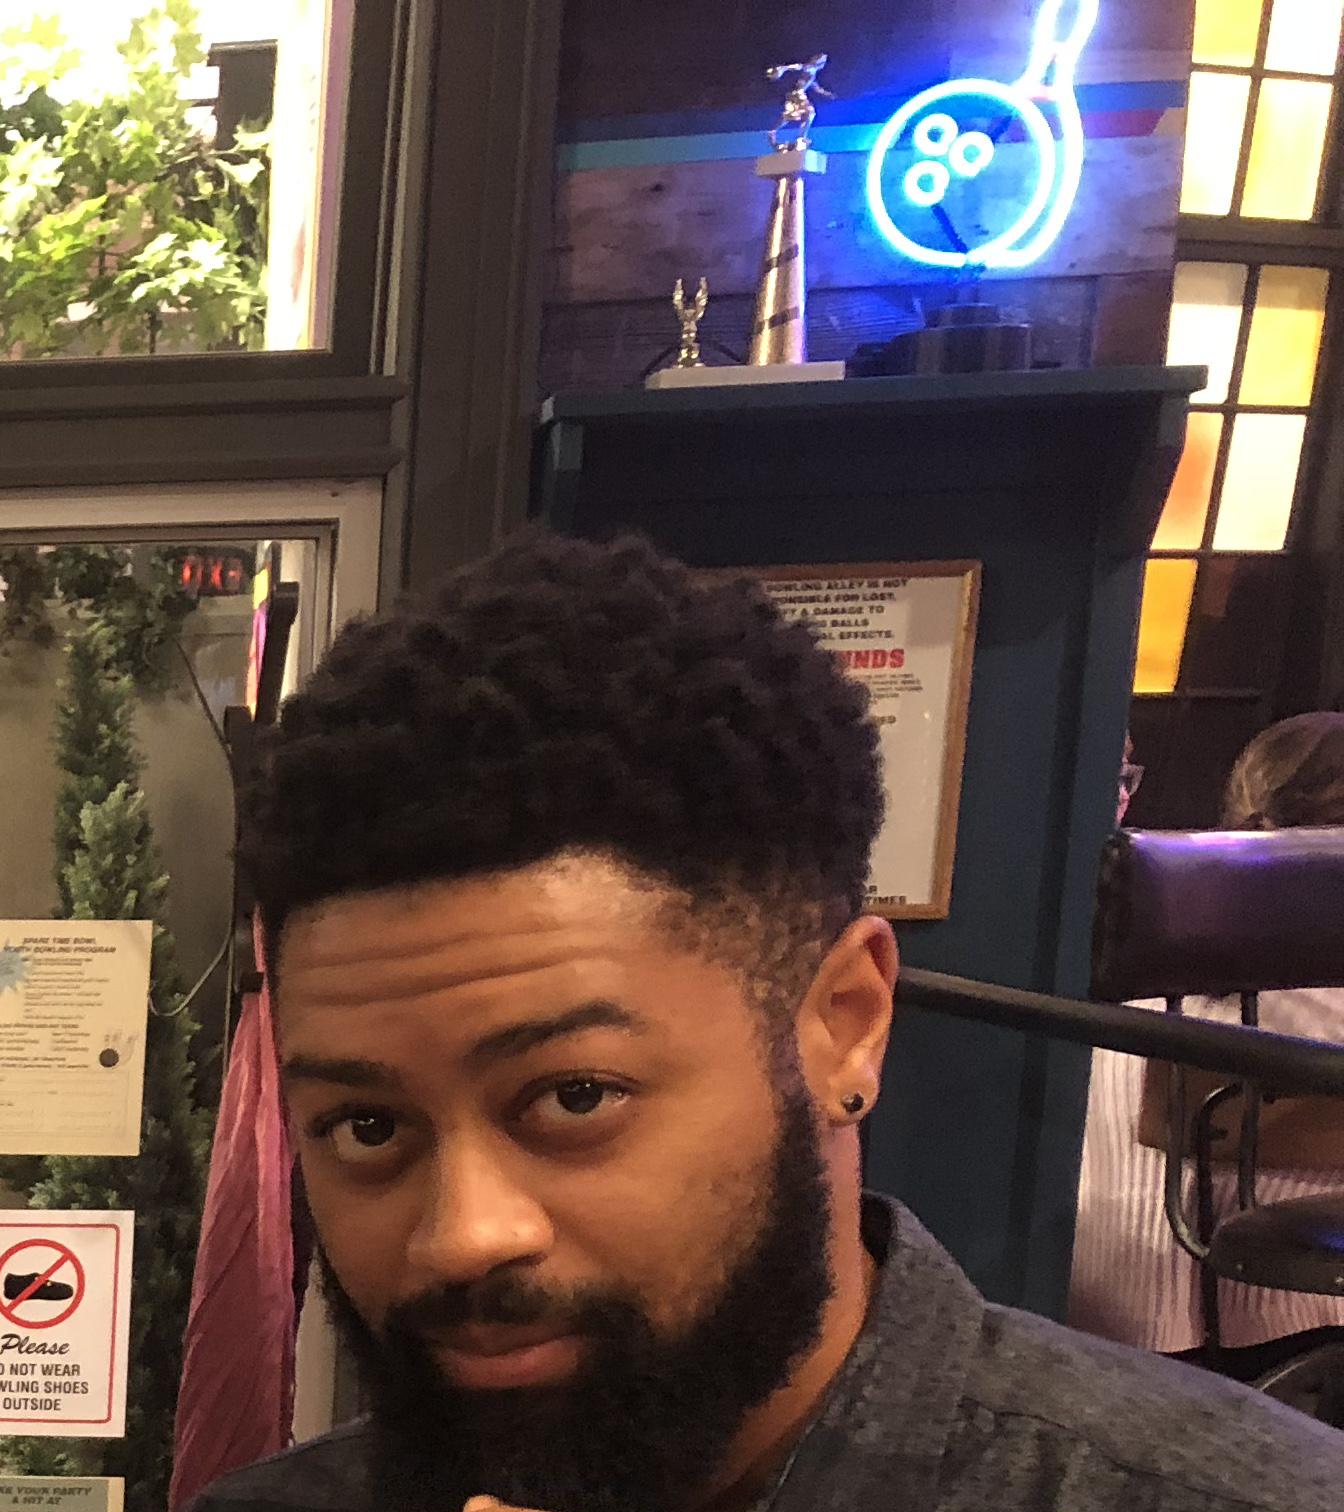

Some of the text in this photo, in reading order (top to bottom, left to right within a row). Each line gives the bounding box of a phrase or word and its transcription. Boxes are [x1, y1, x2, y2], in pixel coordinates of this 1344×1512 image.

[826, 579, 864, 590] ALLEY
[883, 578, 909, 588] NOT
[834, 593, 861, 603] FOR
[813, 605, 864, 616] DAMAGE
[869, 605, 885, 614] TO
[831, 618, 870, 627] BALLS
[0, 1333, 70, 1356] Please
[9, 1362, 36, 1377] NOT
[40, 1362, 81, 1377] WEAR
[44, 1380, 89, 1395] SHOES
[2, 1397, 62, 1411] OUTSIDE
[52, 1486, 92, 1496] PARTY
